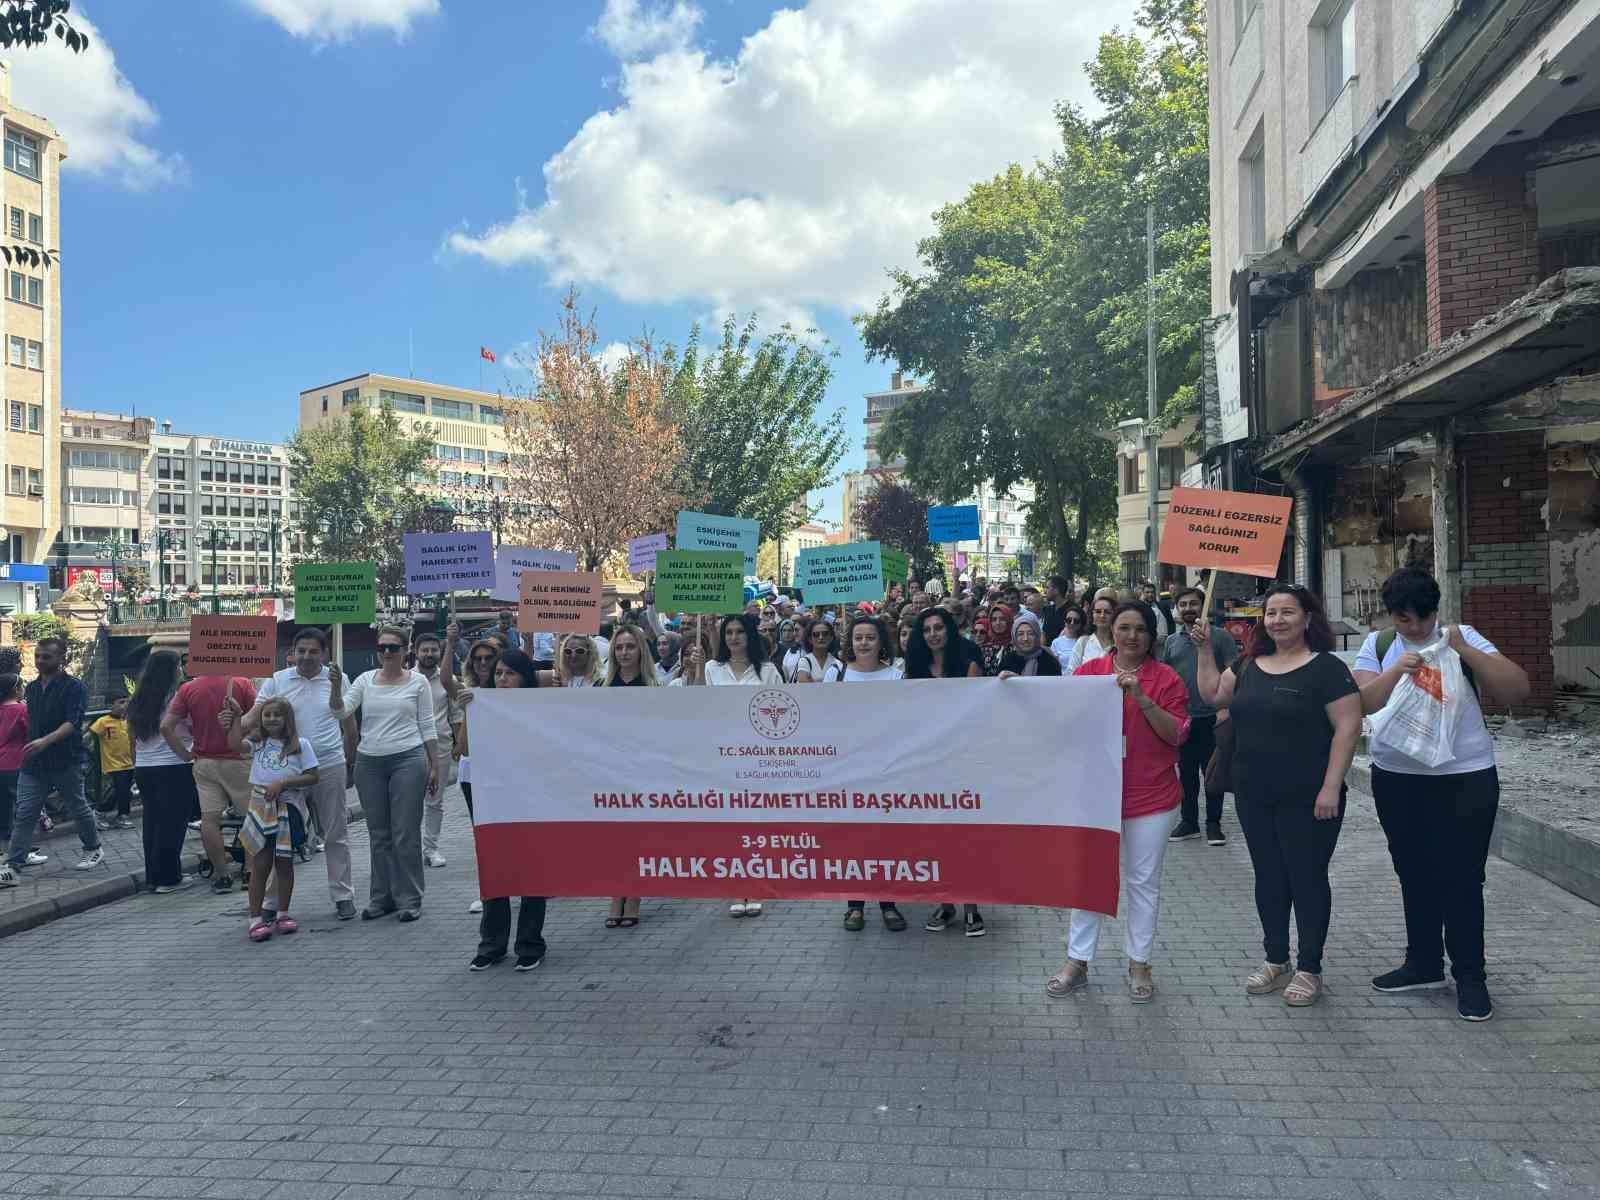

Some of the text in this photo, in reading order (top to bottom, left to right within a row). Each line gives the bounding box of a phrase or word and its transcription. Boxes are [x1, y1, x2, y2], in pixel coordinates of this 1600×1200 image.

[1173, 504, 1283, 525] DÜZENLİ EGZERSİZ
[696, 526, 741, 538] ESKİŞEHİR
[1188, 523, 1258, 539] SAĞLIĞINIZI
[421, 544, 477, 554] SAĞLIK İÇİN
[697, 538, 738, 550] YÜRÜYOR
[1199, 542, 1240, 554] KORUR
[421, 557, 464, 567] HAREKET
[695, 561, 732, 569] DAVRAN
[660, 571, 740, 579] HAYATINI KURTAR
[810, 567, 827, 576] HER
[532, 584, 548, 593] AİLE
[674, 583, 697, 591] KALP
[718, 745, 837, 756] T.C. SAĞLIK BAKANLIĞI
[594, 787, 981, 813] HALK SAĞLIĞI HİZMETLERİ BAŞKANLIĞI
[741, 832, 821, 849] 3-9 EYLÜL
[638, 853, 940, 882] HALK SAĞLIĞI HAFTASI
